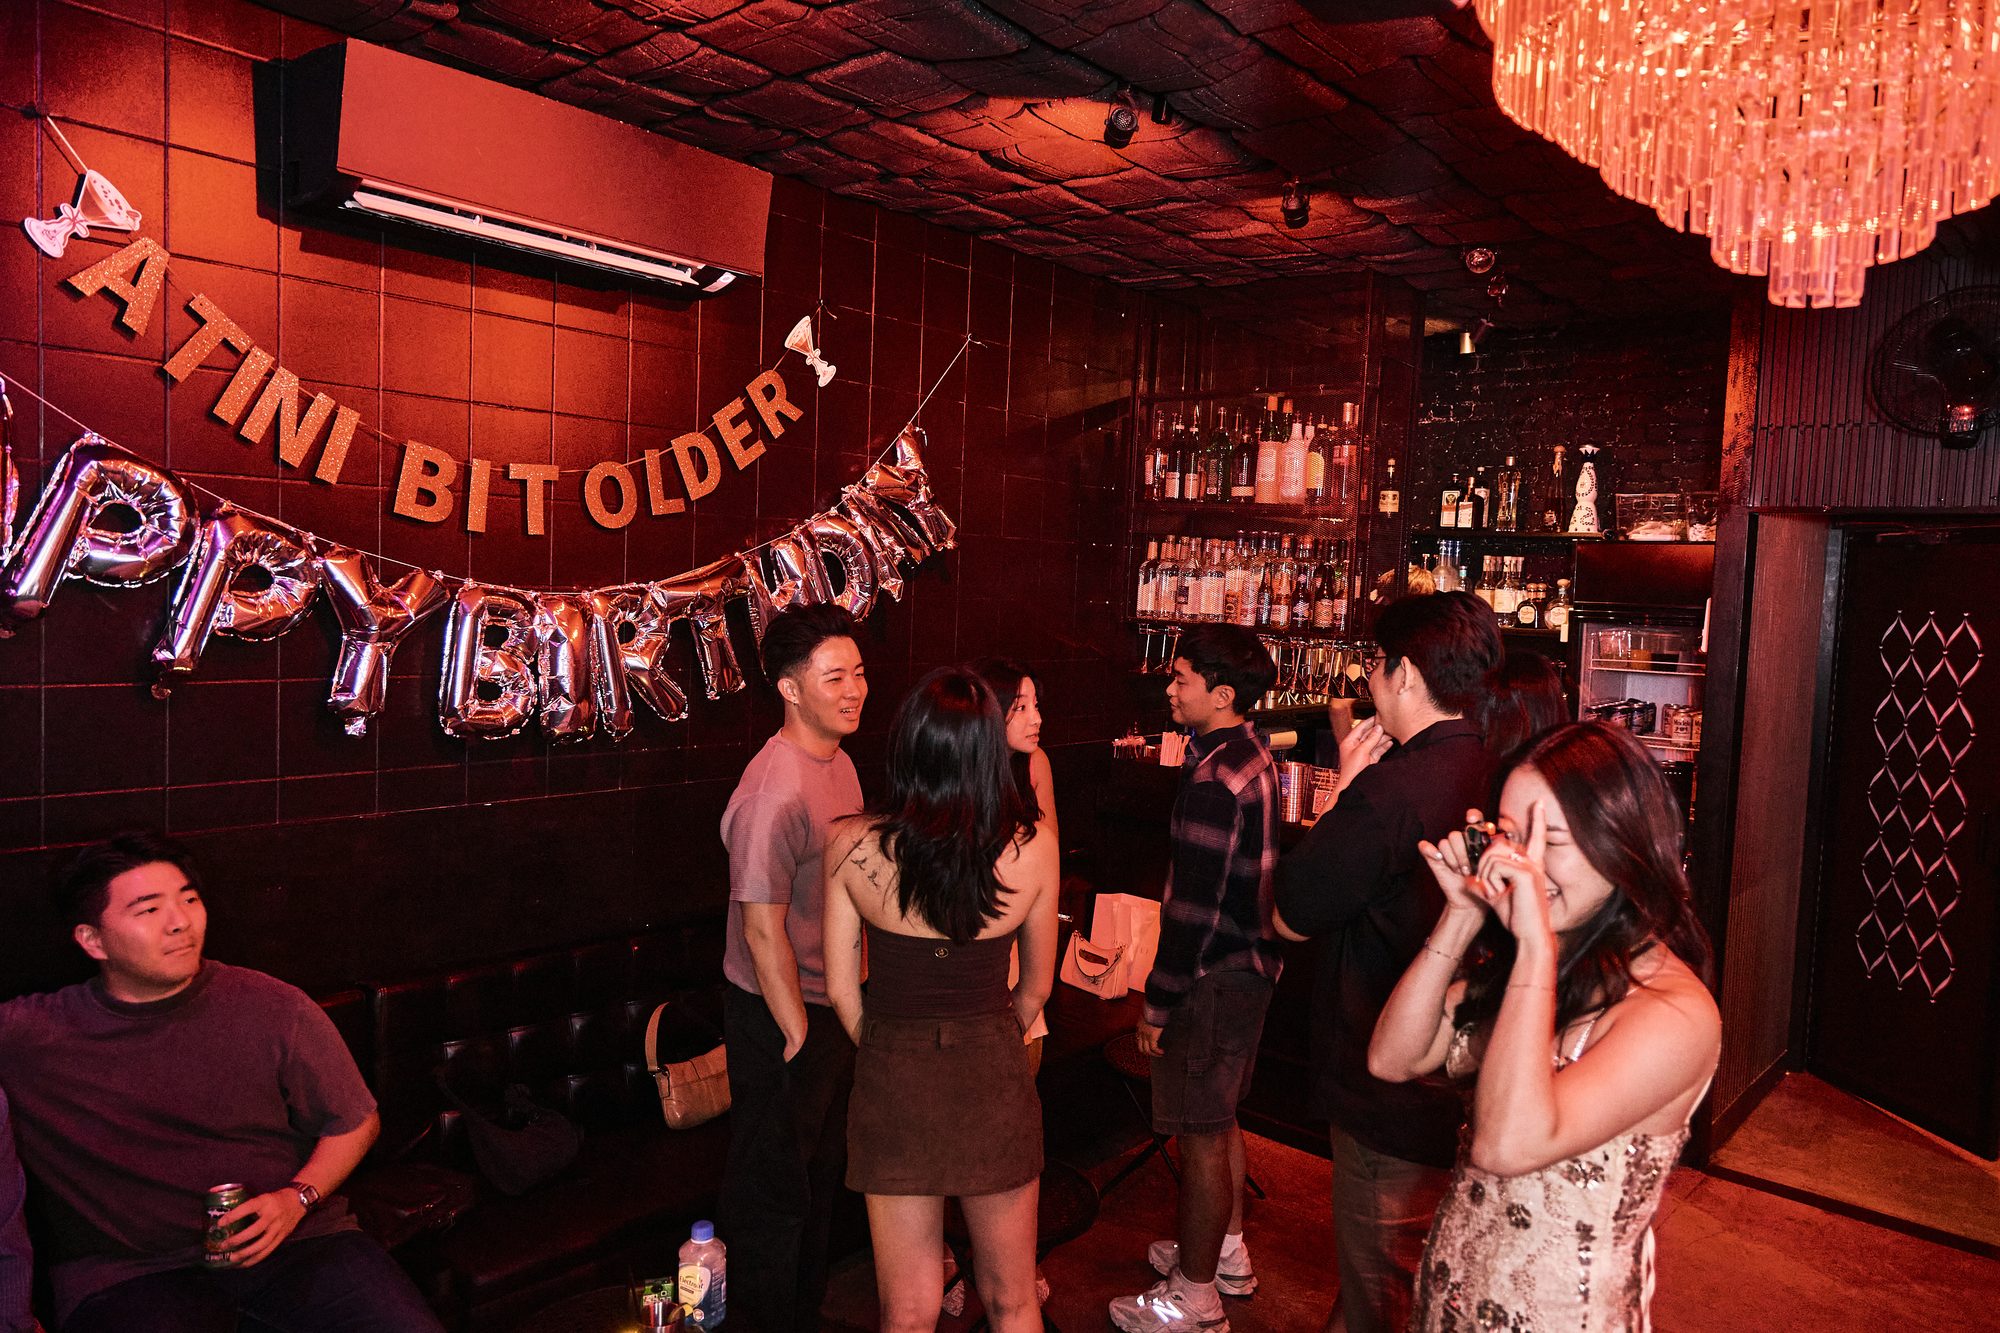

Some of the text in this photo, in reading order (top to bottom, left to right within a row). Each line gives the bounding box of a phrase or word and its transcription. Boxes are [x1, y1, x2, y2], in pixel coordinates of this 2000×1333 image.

[67, 237, 804, 536] A TINI BIT OLDER
[0, 376, 450, 738] PPY
